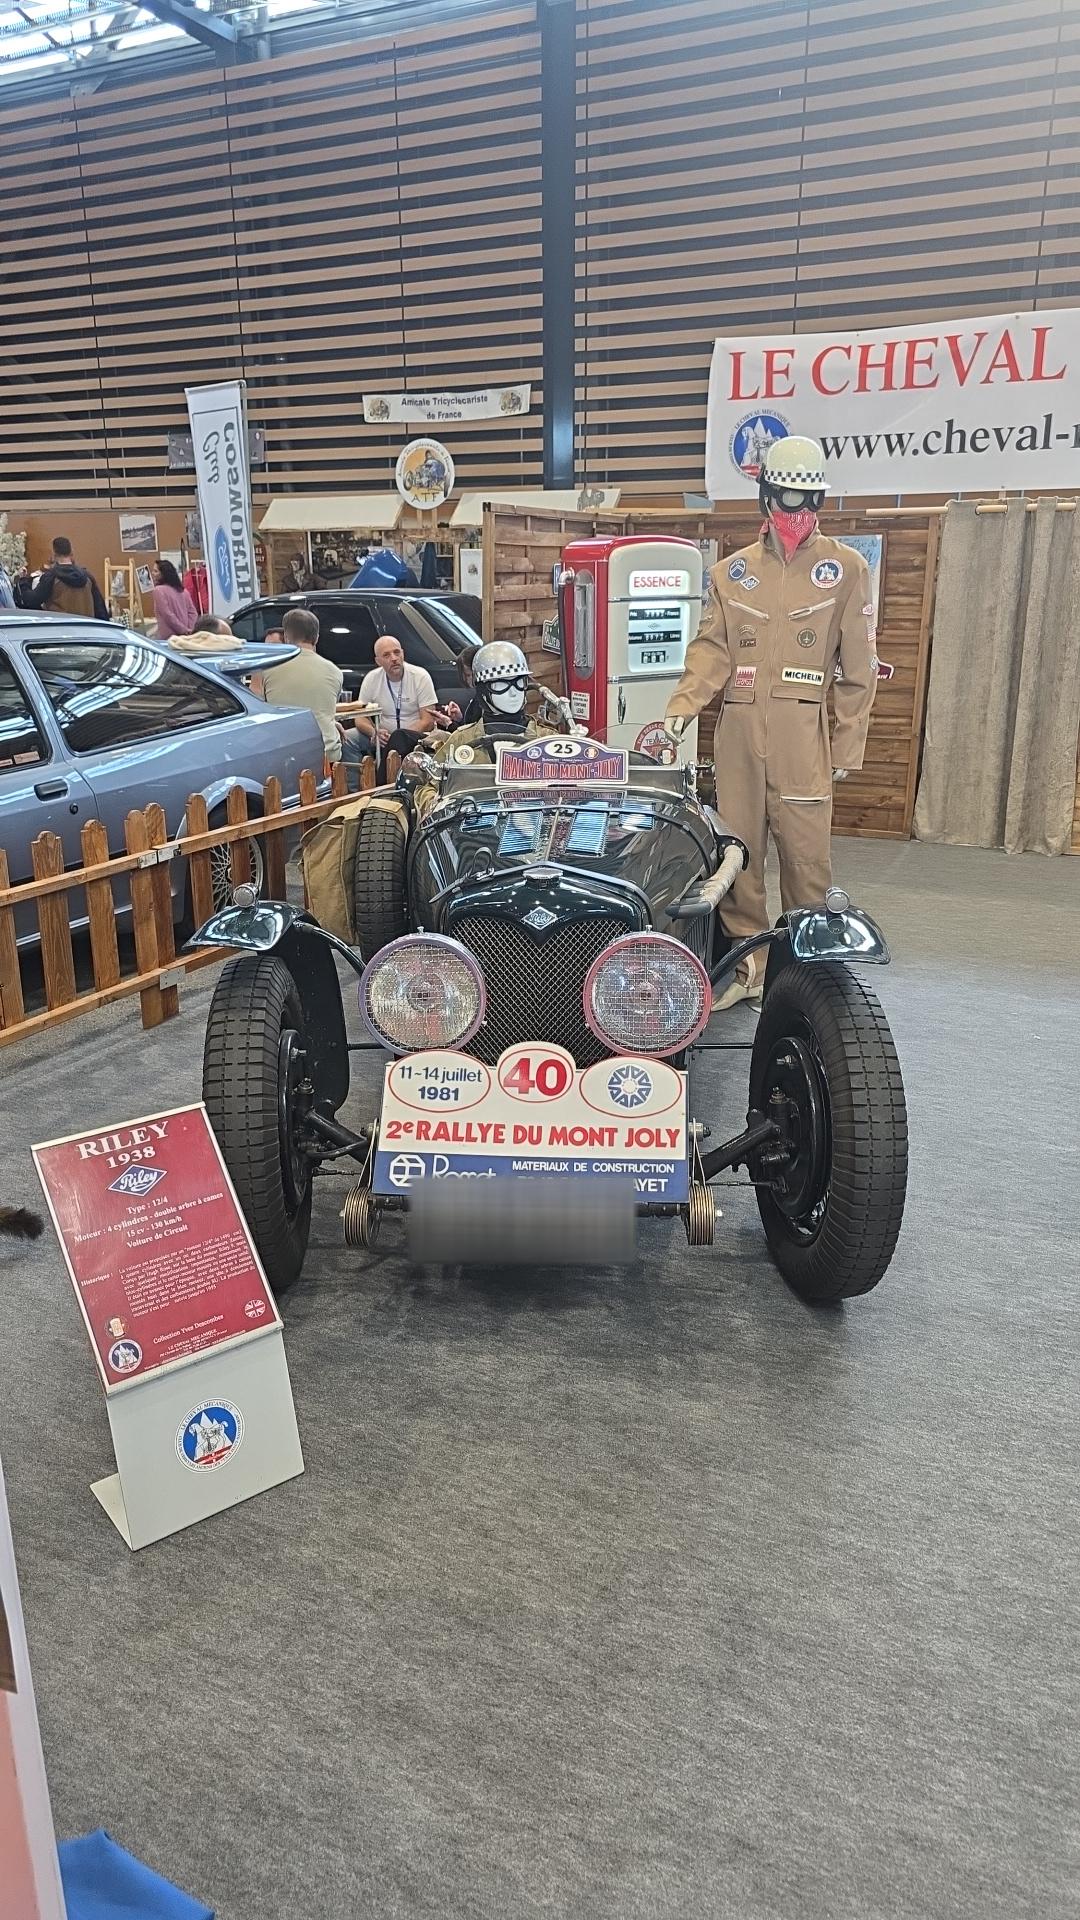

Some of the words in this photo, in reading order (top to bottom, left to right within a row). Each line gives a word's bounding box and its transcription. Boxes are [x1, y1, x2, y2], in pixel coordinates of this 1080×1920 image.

[728, 349, 796, 401] LE
[811, 327, 1068, 396] CHEVAL
[401, 398, 430, 406] Amicale
[427, 412, 436, 420] de
[437, 411, 462, 419] France
[819, 413, 1080, 460] www.cheval-
[633, 575, 681, 588] ESSENCE
[784, 670, 822, 682] MICHELIN
[553, 743, 573, 754] 25
[503, 753, 541, 780] RALLYE
[543, 762, 559, 779] DU
[440, 1067, 483, 1084] juillet
[503, 1057, 568, 1097] 40
[418, 1086, 460, 1101] 1981
[75, 1121, 169, 1160] RILEY
[415, 1121, 507, 1145] RALLYE
[513, 1125, 544, 1145] DU
[548, 1126, 618, 1148] MONT
[624, 1128, 681, 1148] JOLY
[106, 1145, 156, 1169] 1938
[512, 1160, 569, 1172] MATERIAUX
[573, 1162, 588, 1172] DE
[592, 1162, 675, 1174] CONSTRUCTION
[119, 1169, 158, 1192] Riley
[633, 1178, 669, 1192] AYET
[126, 1205, 146, 1215] Type
[152, 1196, 169, 1207] 12/4
[74, 1229, 102, 1244] Moteur
[113, 1214, 149, 1232] cylindres
[154, 1206, 178, 1219] double
[178, 1200, 197, 1211] arbre
[203, 1192, 224, 1203] cames
[126, 1230, 136, 1238] 15
[136, 1228, 145, 1236] cv
[163, 1215, 183, 1227] km/h
[126, 1235, 153, 1249] Voiture
[154, 1232, 164, 1241] de
[163, 1223, 189, 1237] Circuit
[81, 1273, 111, 1287] Historique
[153, 1329, 181, 1345] Collection
[181, 1324, 195, 1334] Yves
[194, 1314, 224, 1329] Descombes
[185, 1405, 203, 1423] CHEVAL
